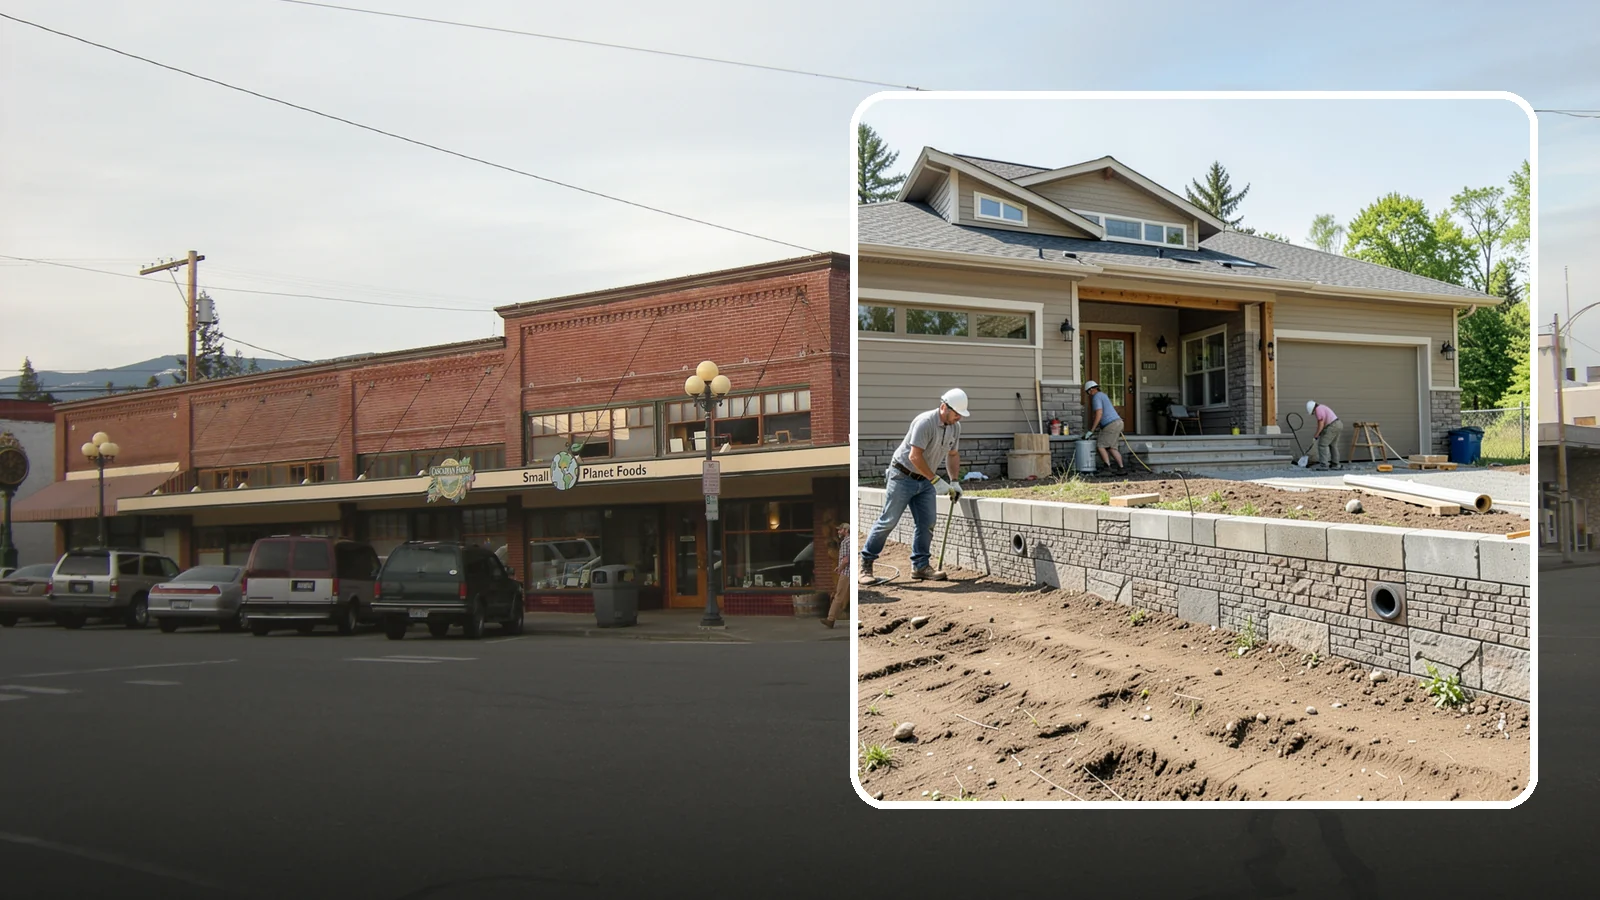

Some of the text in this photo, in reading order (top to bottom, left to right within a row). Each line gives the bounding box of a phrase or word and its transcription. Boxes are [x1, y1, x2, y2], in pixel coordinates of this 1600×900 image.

[523, 464, 647, 483] Small Planet Foods
